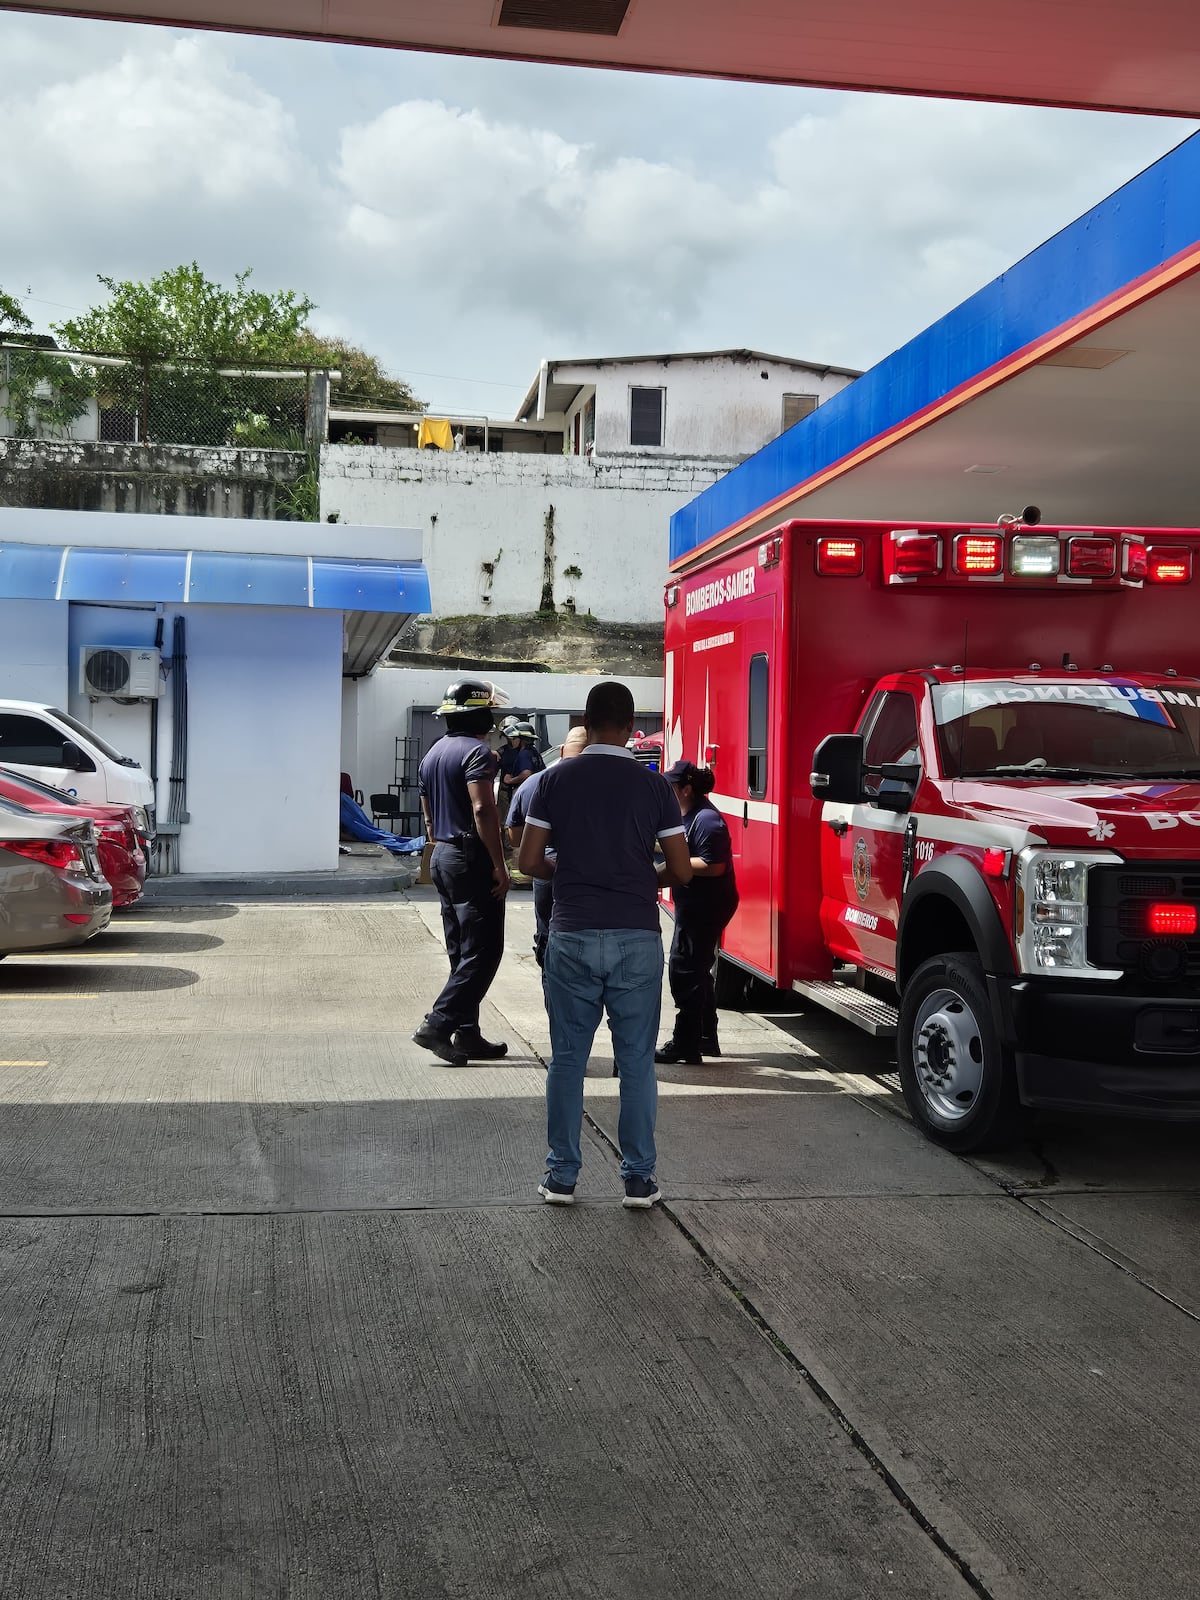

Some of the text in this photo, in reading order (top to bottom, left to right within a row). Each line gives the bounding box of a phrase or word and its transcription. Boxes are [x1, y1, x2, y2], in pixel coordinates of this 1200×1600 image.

[686, 566, 755, 616] BOMBEROS-SAMER
[915, 841, 934, 861] 1016
[845, 907, 879, 930] BOMBEROS
